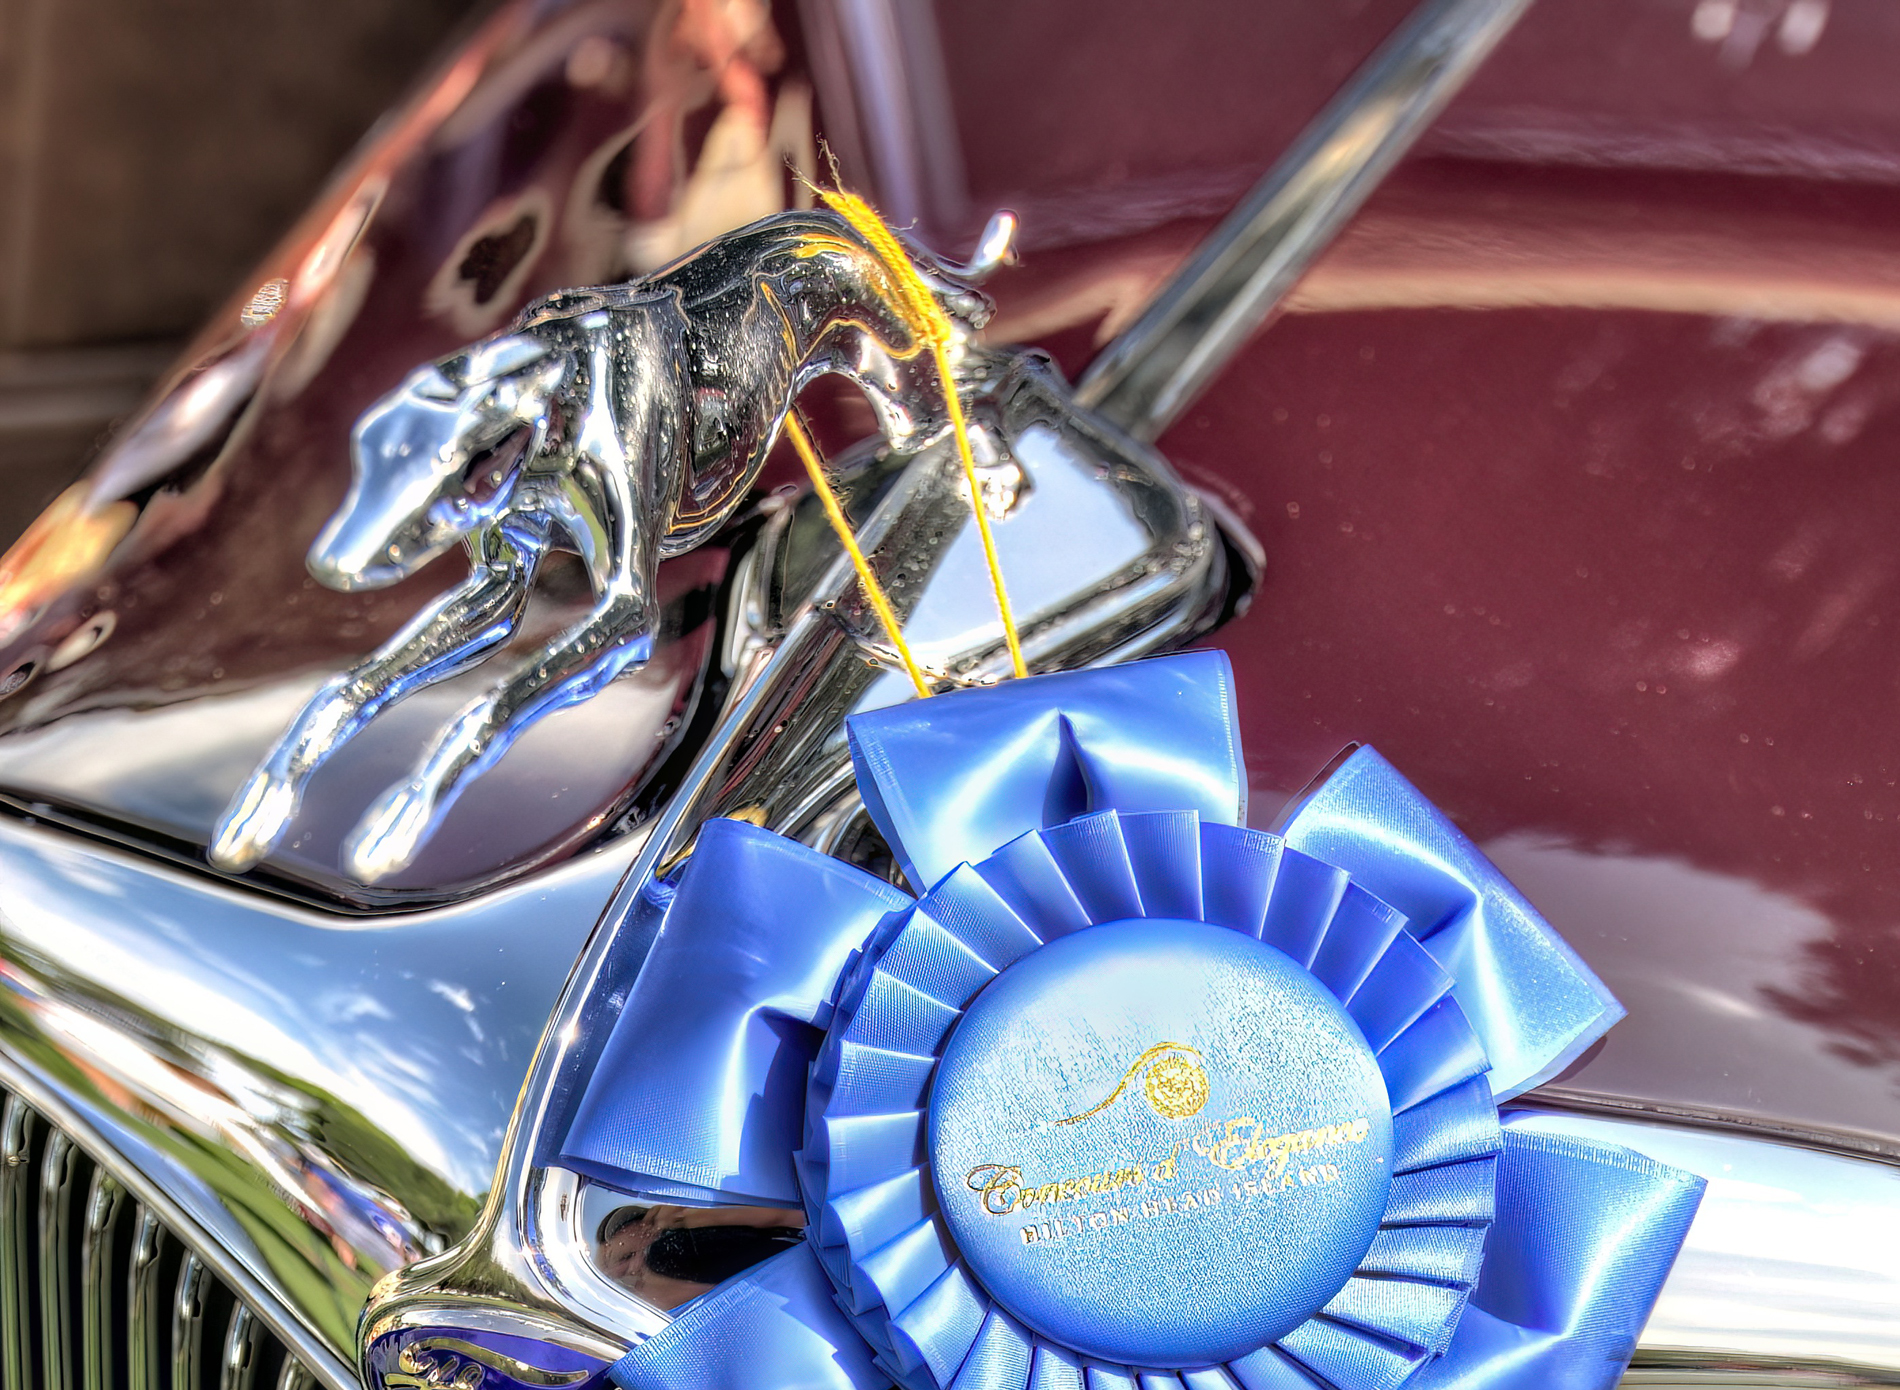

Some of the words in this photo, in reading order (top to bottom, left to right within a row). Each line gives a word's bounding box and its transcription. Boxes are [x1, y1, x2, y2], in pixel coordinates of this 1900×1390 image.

[1019, 1206, 1131, 1246] HILTON
[1141, 1186, 1222, 1220] HEAD
[1231, 1162, 1340, 1201] ISLAND
